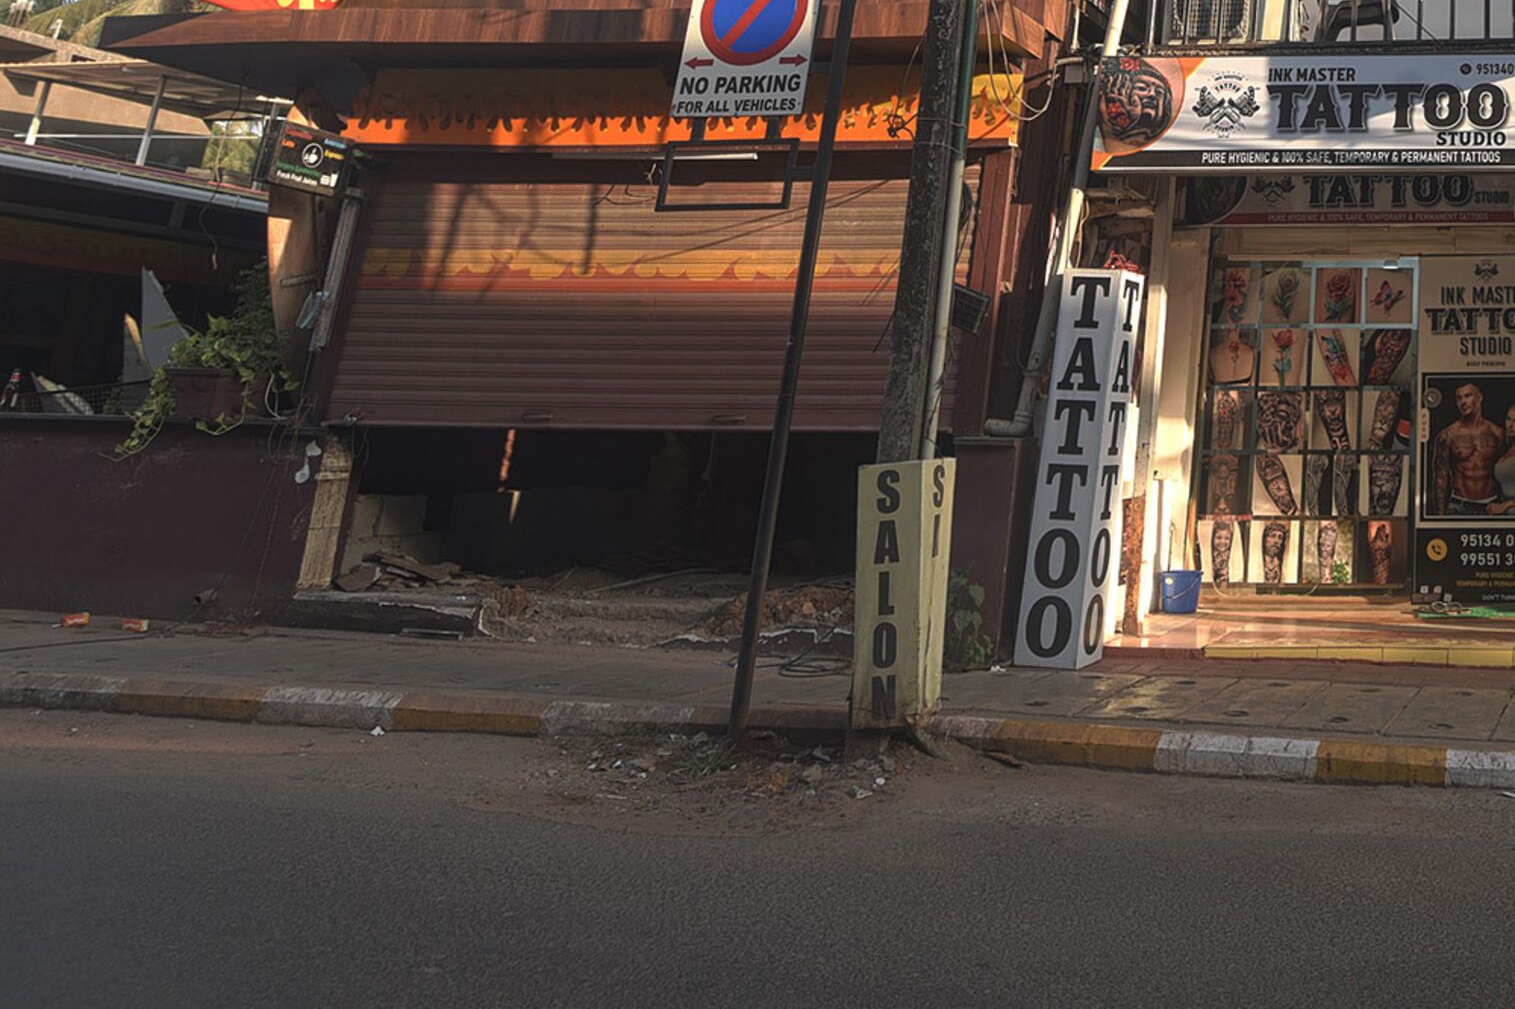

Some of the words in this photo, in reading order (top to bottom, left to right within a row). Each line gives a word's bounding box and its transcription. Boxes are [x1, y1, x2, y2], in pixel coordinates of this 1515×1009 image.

[1268, 67, 1294, 82] INK
[1297, 67, 1356, 82] MASTER
[679, 77, 709, 95] NO
[714, 74, 801, 94] PARKING
[676, 101, 703, 114] FOR
[705, 100, 730, 113] ALL
[734, 98, 796, 112] VEHICLES
[1266, 82, 1511, 134] TATTOO
[1436, 131, 1506, 147] STUDIO
[1202, 152, 1227, 164] PURE
[1228, 152, 1270, 164] HYGIENIC
[1272, 152, 1280, 164] &
[1281, 151, 1304, 164] 100%
[1306, 151, 1333, 165] SAFE,
[1334, 151, 1390, 163] TEMPORARY
[1391, 151, 1399, 163] &
[1401, 151, 1458, 163] PERMANENT
[1460, 151, 1500, 163] TATTOOS
[1303, 175, 1474, 207] TATTOO
[1474, 190, 1510, 204] STUDIO
[1441, 286, 1465, 305] INK
[1460, 337, 1512, 356] STUDIO
[1026, 276, 1111, 659] TATTOO
[1084, 280, 1139, 656] TATTOO
[1460, 533, 1501, 548] 95134
[1460, 552, 1500, 566] 99551
[871, 469, 900, 720] SALON
